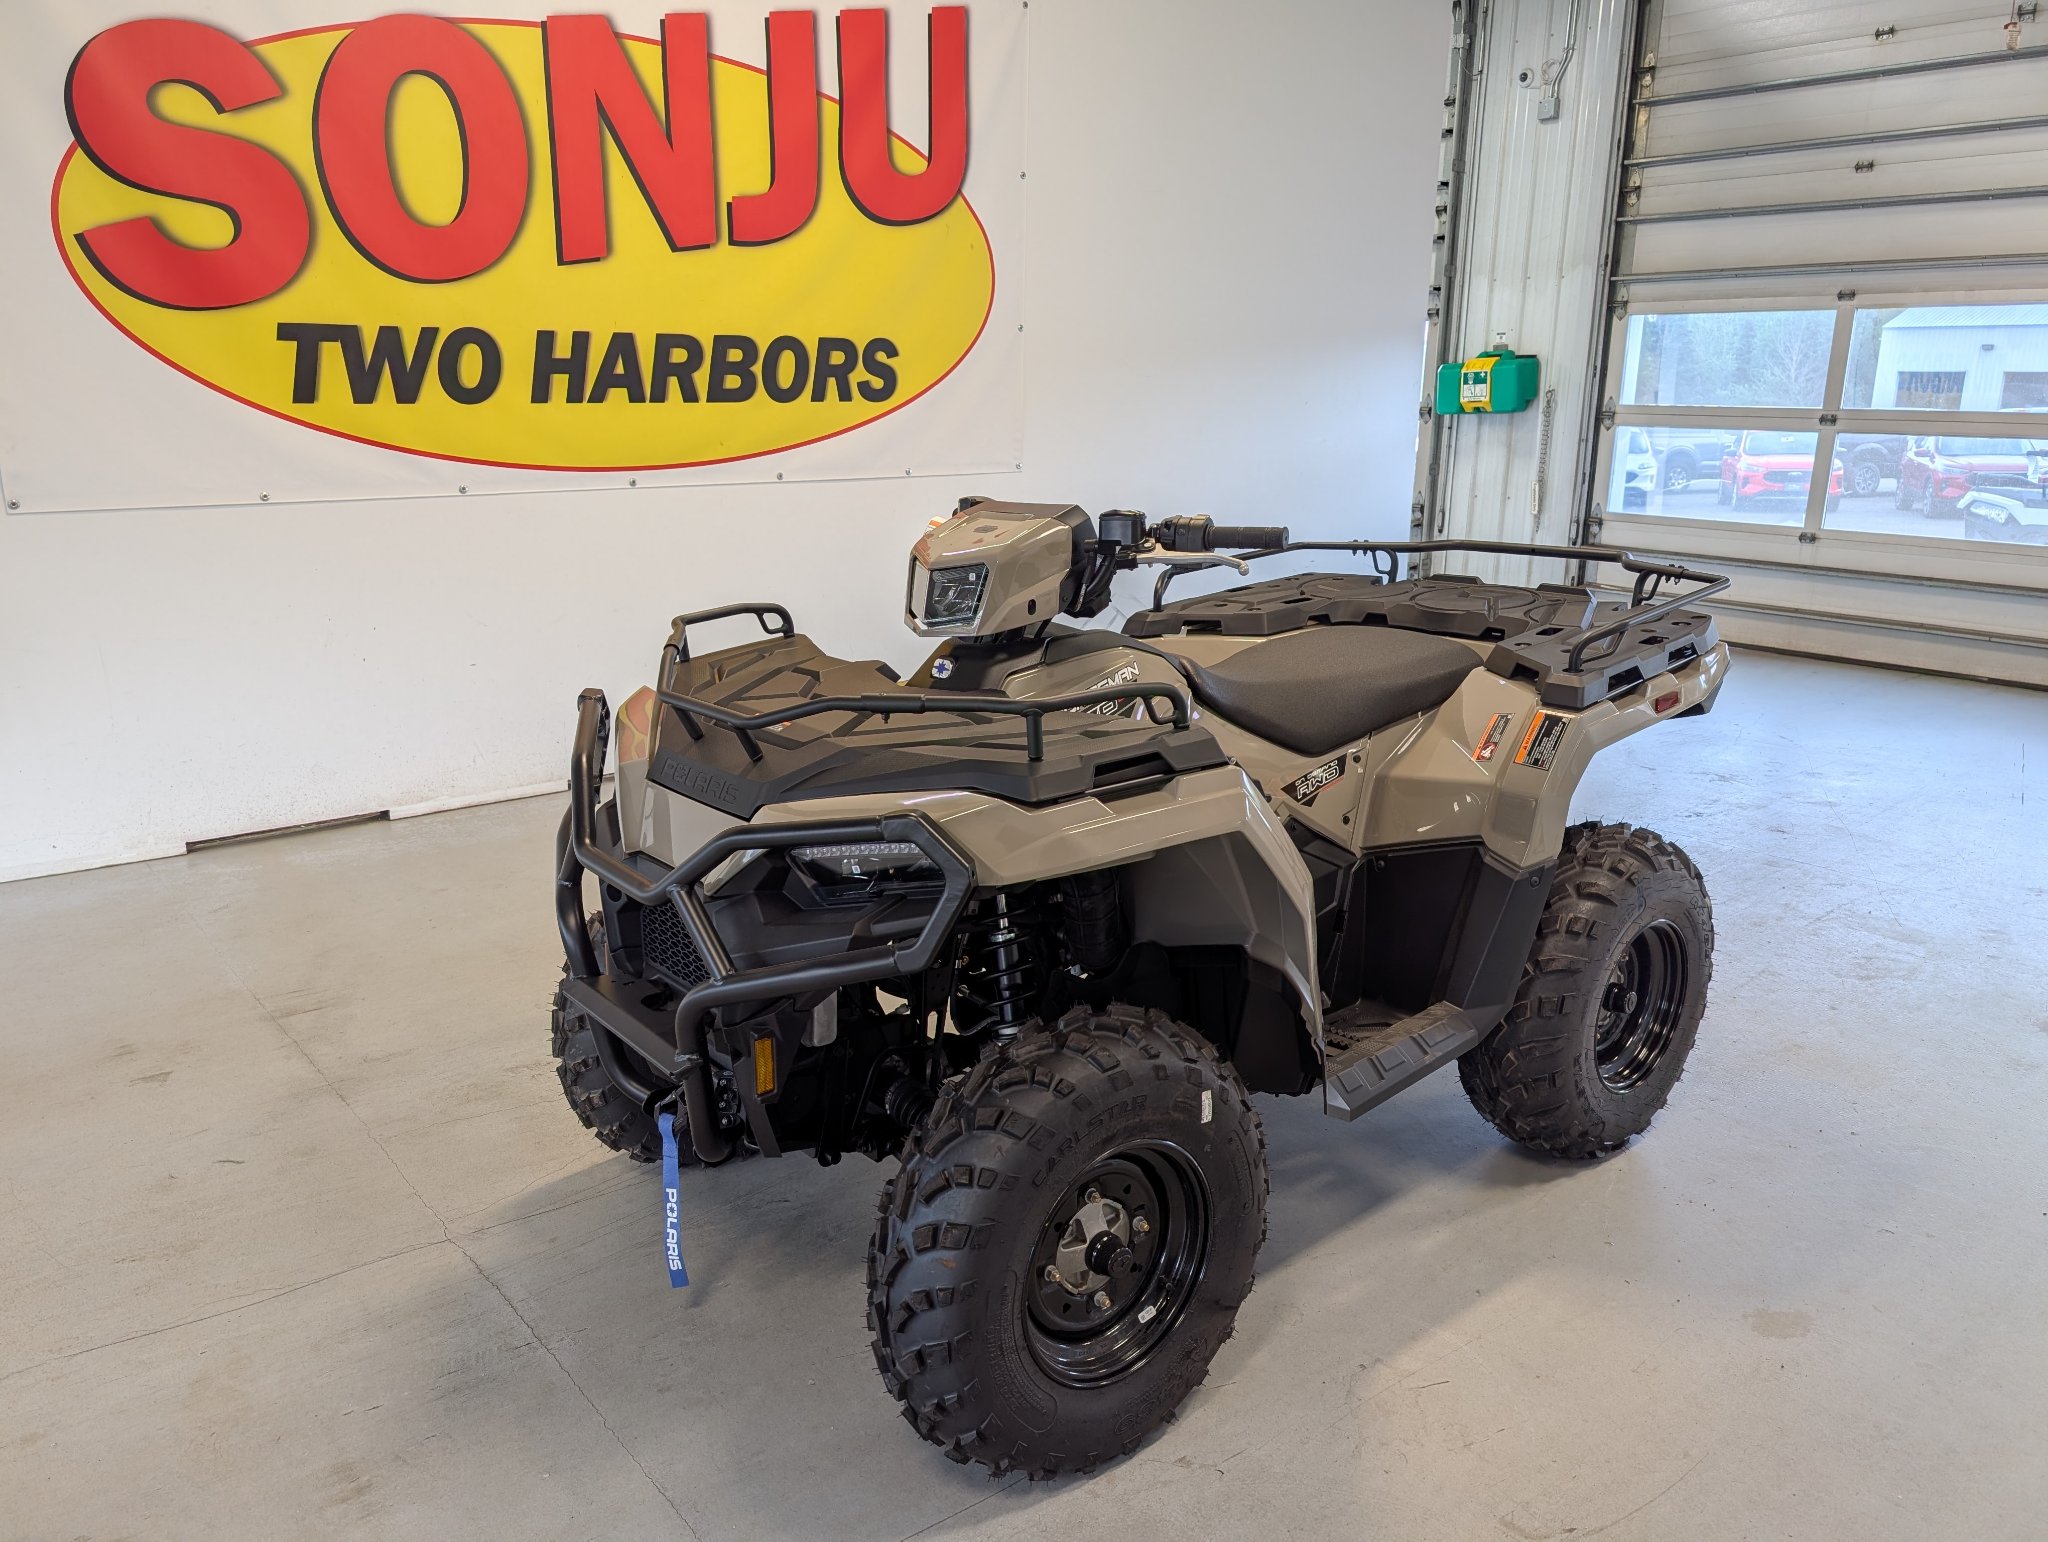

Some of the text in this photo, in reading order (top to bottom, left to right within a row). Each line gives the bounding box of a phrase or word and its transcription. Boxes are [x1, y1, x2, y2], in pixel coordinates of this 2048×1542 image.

[65, 6, 968, 310] SONJU
[276, 321, 899, 405] TWO HARBORS
[660, 757, 740, 805] POLARIS
[1296, 765, 1340, 799] AWD
[665, 1187, 682, 1271] POLARIS
